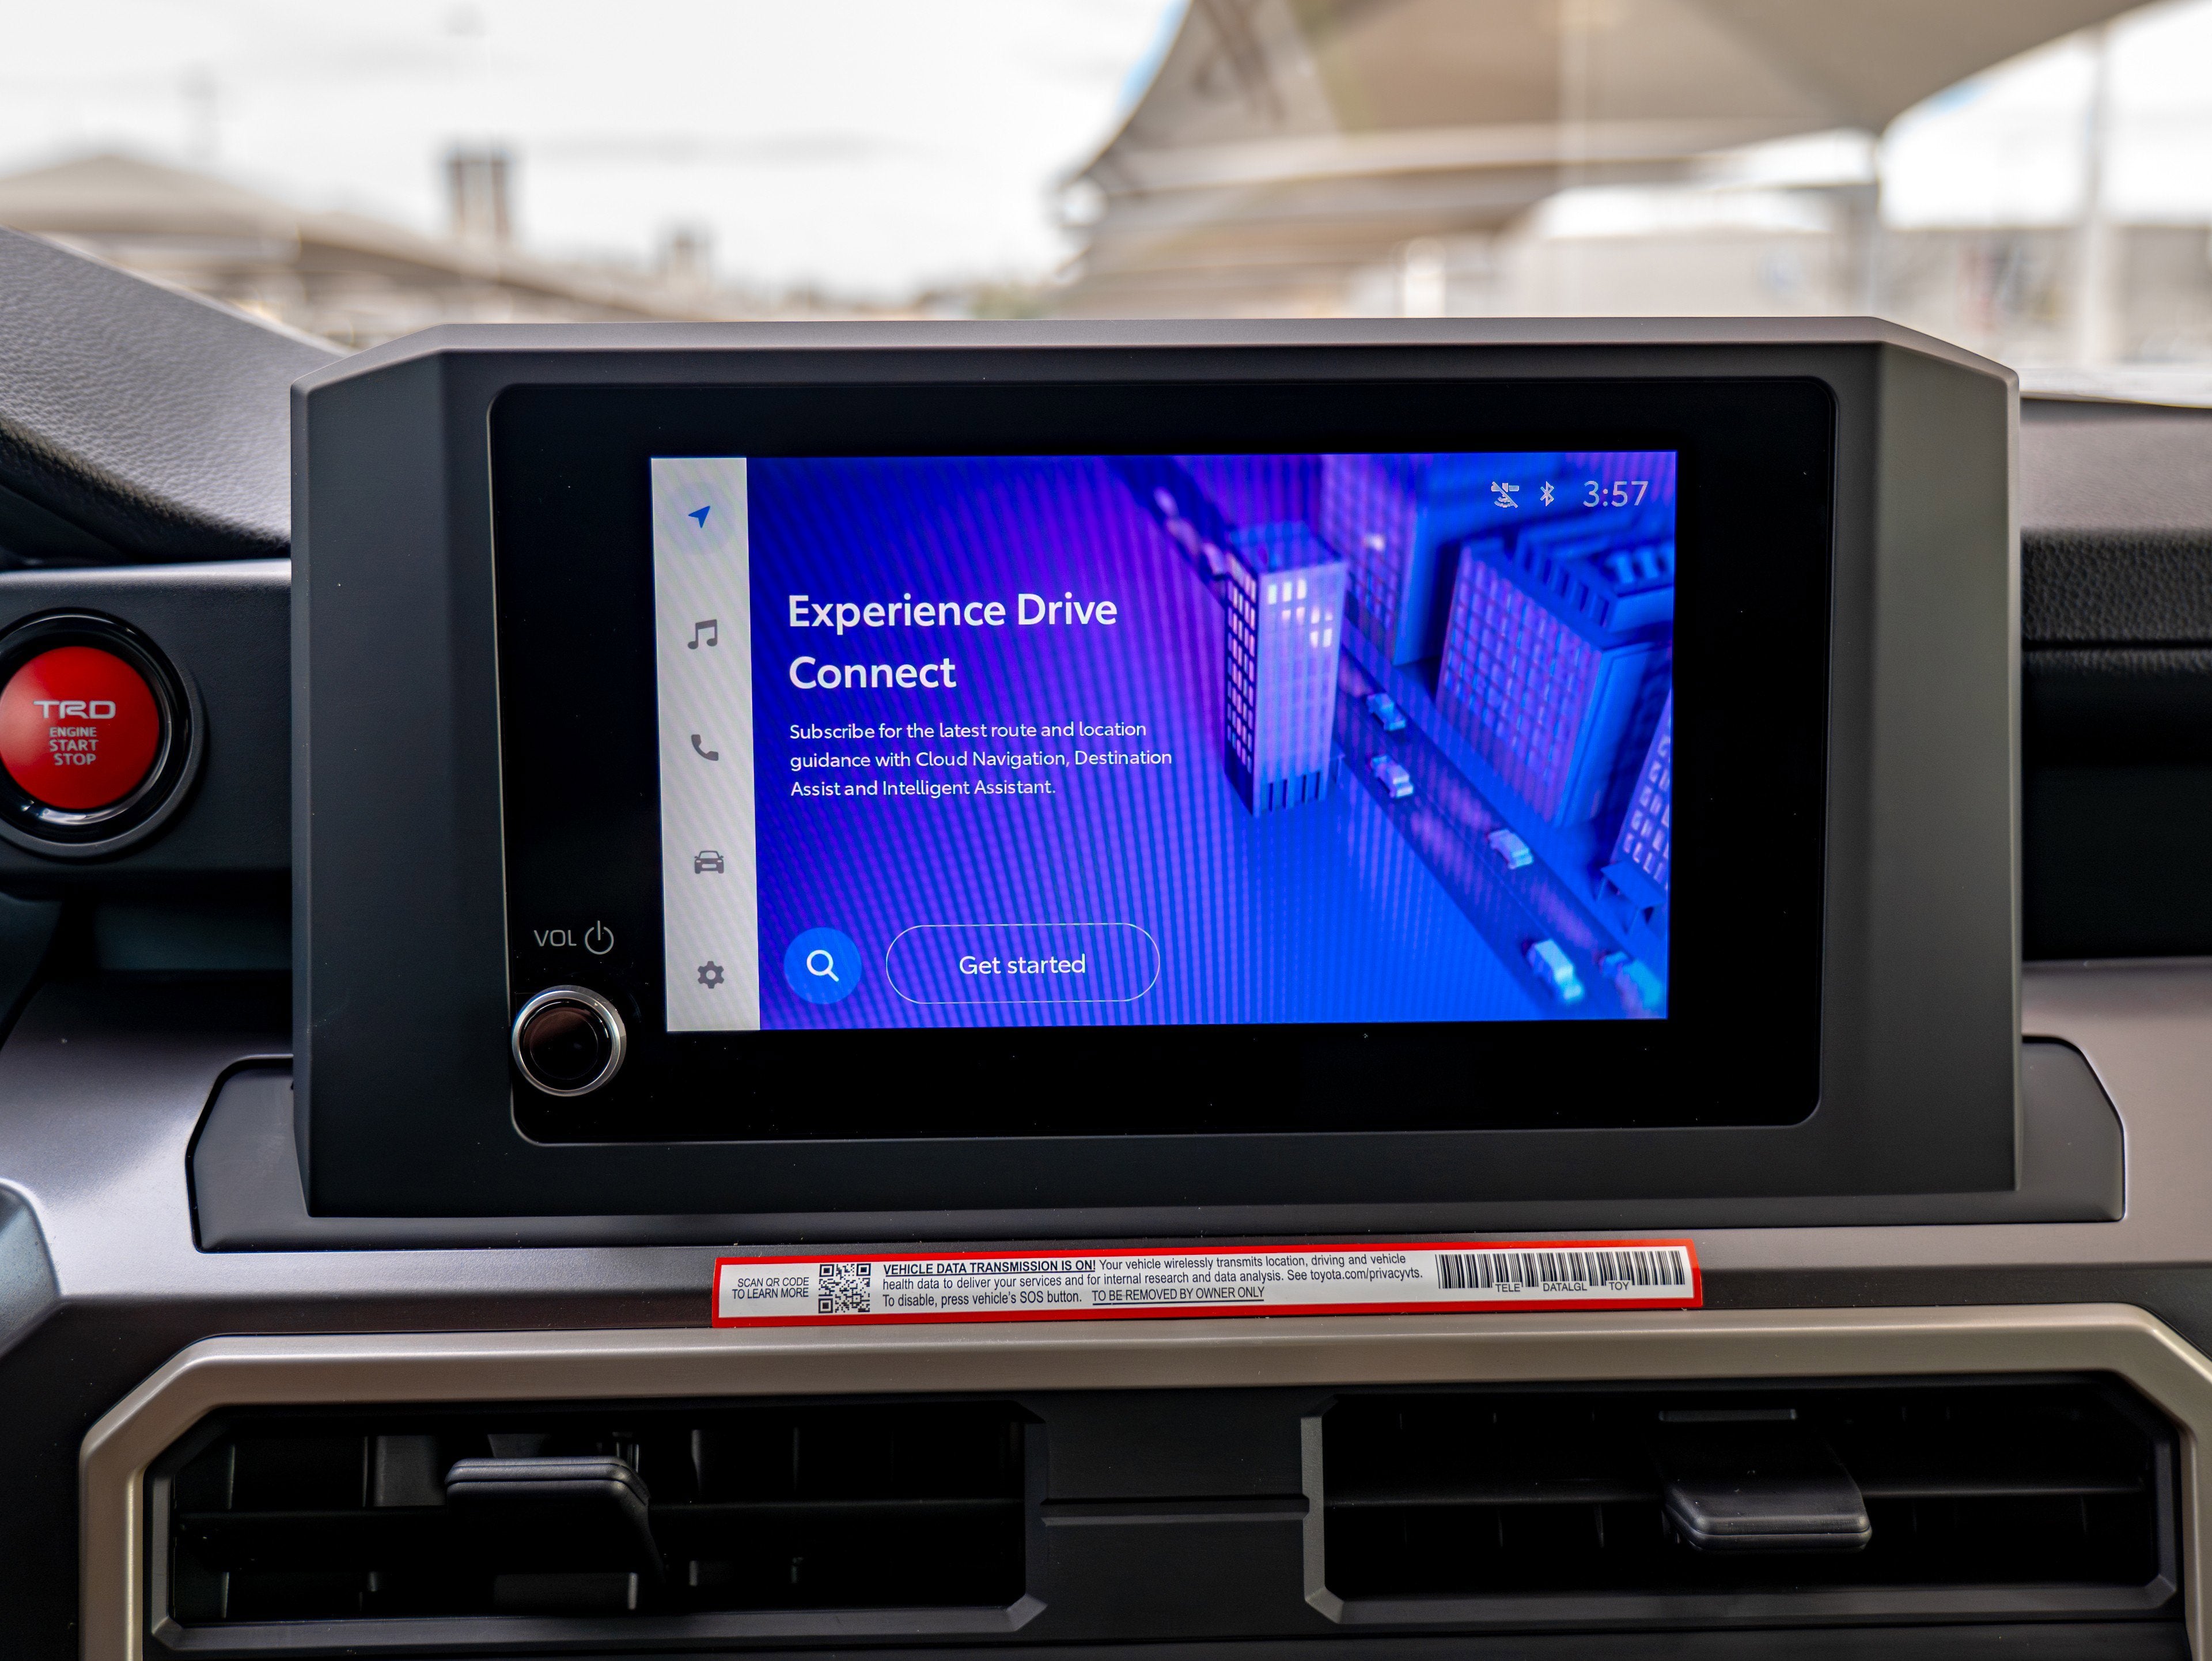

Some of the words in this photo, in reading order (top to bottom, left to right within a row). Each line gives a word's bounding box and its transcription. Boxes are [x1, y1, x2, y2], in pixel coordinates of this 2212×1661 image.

[1583, 480, 1649, 507] 3:57
[789, 593, 1006, 635] Experience
[1018, 592, 1118, 626] Drive
[789, 656, 957, 690] Connect
[33, 701, 116, 718] TRD
[49, 727, 97, 737] ENGINE
[789, 724, 875, 740] Subscribe
[878, 724, 903, 739] for
[906, 723, 934, 739] the
[940, 723, 987, 739] latest
[991, 724, 1037, 738] route
[1040, 722, 1074, 737] and
[1079, 721, 1147, 737] location
[49, 739, 99, 752] START
[54, 753, 96, 766] STOP
[790, 752, 871, 771] guidance
[875, 752, 911, 767] with
[916, 751, 968, 767] Cloud
[972, 751, 1070, 769] Navigation,
[1075, 750, 1172, 766] Destination
[791, 781, 841, 797] Assist
[844, 781, 878, 796] and
[882, 780, 970, 798] Intelligent
[974, 780, 1056, 795] Assistant.
[533, 929, 577, 948] VOL
[959, 955, 1002, 975] Get
[1006, 953, 1087, 975] started
[883, 1263, 934, 1275] VEHICLE
[936, 1263, 967, 1274] DATA
[969, 1261, 1058, 1274] TRANSMISSION
[1061, 1260, 1073, 1272] IS
[1075, 1259, 1096, 1272] ON!
[1100, 1259, 1123, 1270] Your
[1126, 1258, 1161, 1270] vehicle
[1164, 1257, 1213, 1271] wirelessly
[1216, 1256, 1263, 1267] transmits
[1266, 1255, 1308, 1268] location,
[1311, 1254, 1345, 1268] driving
[1348, 1254, 1368, 1266] and
[1370, 1254, 1406, 1265] vehicle
[737, 1278, 763, 1287] SCAN
[766, 1277, 781, 1287] QR
[782, 1277, 809, 1286] CODE
[883, 1278, 914, 1291] health
[916, 1278, 940, 1289] data
[942, 1278, 953, 1289] to
[957, 1276, 991, 1289] deliver
[994, 1278, 1017, 1291] your
[1019, 1276, 1062, 1288] services
[1065, 1273, 1084, 1285] and
[1087, 1273, 1101, 1285] for
[1104, 1272, 1142, 1284] internal
[1145, 1272, 1190, 1284] research
[1192, 1271, 1211, 1282] and
[1214, 1270, 1236, 1282] data
[1239, 1269, 1284, 1284] analysis.
[1287, 1269, 1308, 1281] See
[1310, 1268, 1423, 1282] toyota.com/privacyvts.
[1495, 1284, 1521, 1292] TELE
[1543, 1282, 1588, 1292] DATALGL
[1609, 1282, 1629, 1291] TOY
[732, 1289, 745, 1299] TO
[747, 1288, 779, 1298] LEARN
[781, 1288, 809, 1297] MORE
[882, 1295, 895, 1307] To
[898, 1294, 938, 1308] disable,
[941, 1295, 969, 1308] press
[1020, 1292, 1044, 1304] SOS
[1047, 1291, 1082, 1303] button.
[1092, 1290, 1106, 1301] TO
[1109, 1289, 1123, 1301] BE
[1126, 1289, 1177, 1300] REMOVED
[1180, 1288, 1194, 1299] BY
[1196, 1287, 1236, 1299] OWNER
[1237, 1287, 1264, 1298] ONLY
